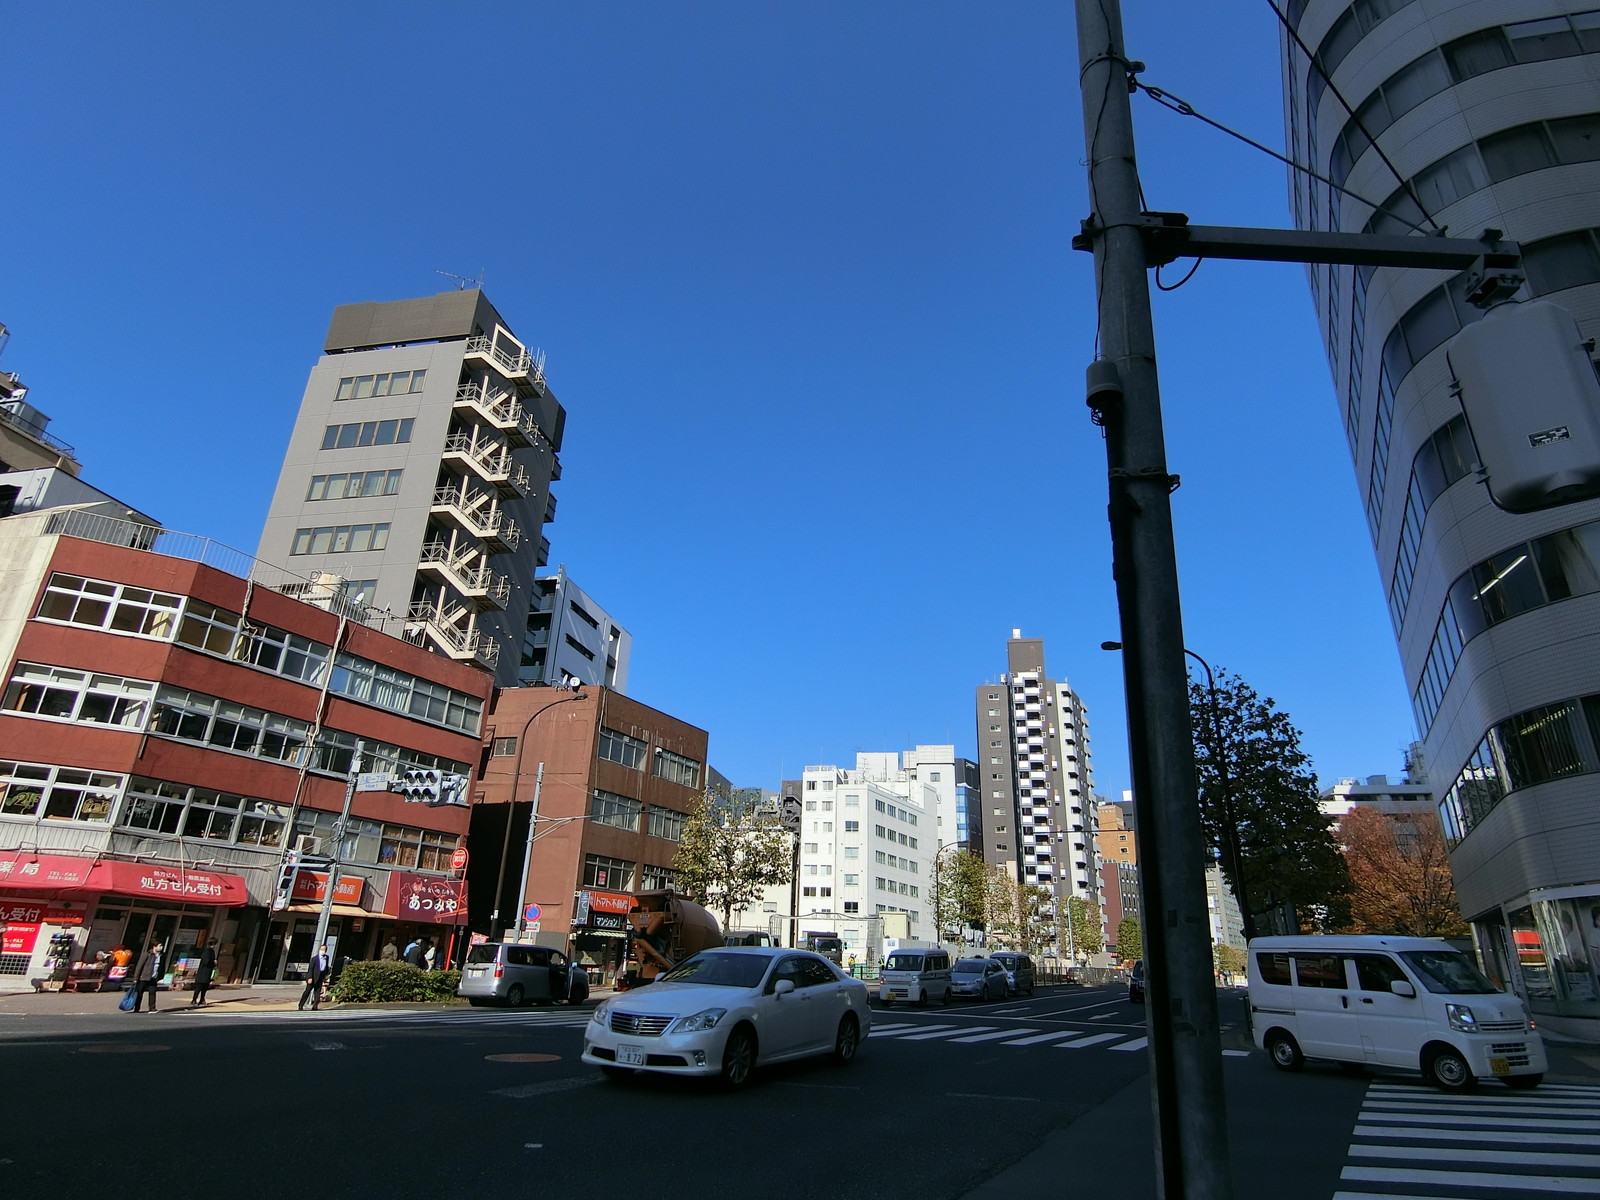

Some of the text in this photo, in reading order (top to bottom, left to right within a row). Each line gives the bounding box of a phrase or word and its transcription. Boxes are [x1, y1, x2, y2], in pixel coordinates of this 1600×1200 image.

[141, 877, 221, 895] 処方せん受付
[408, 893, 457, 913] あつみや
[596, 917, 618, 927] マンション
